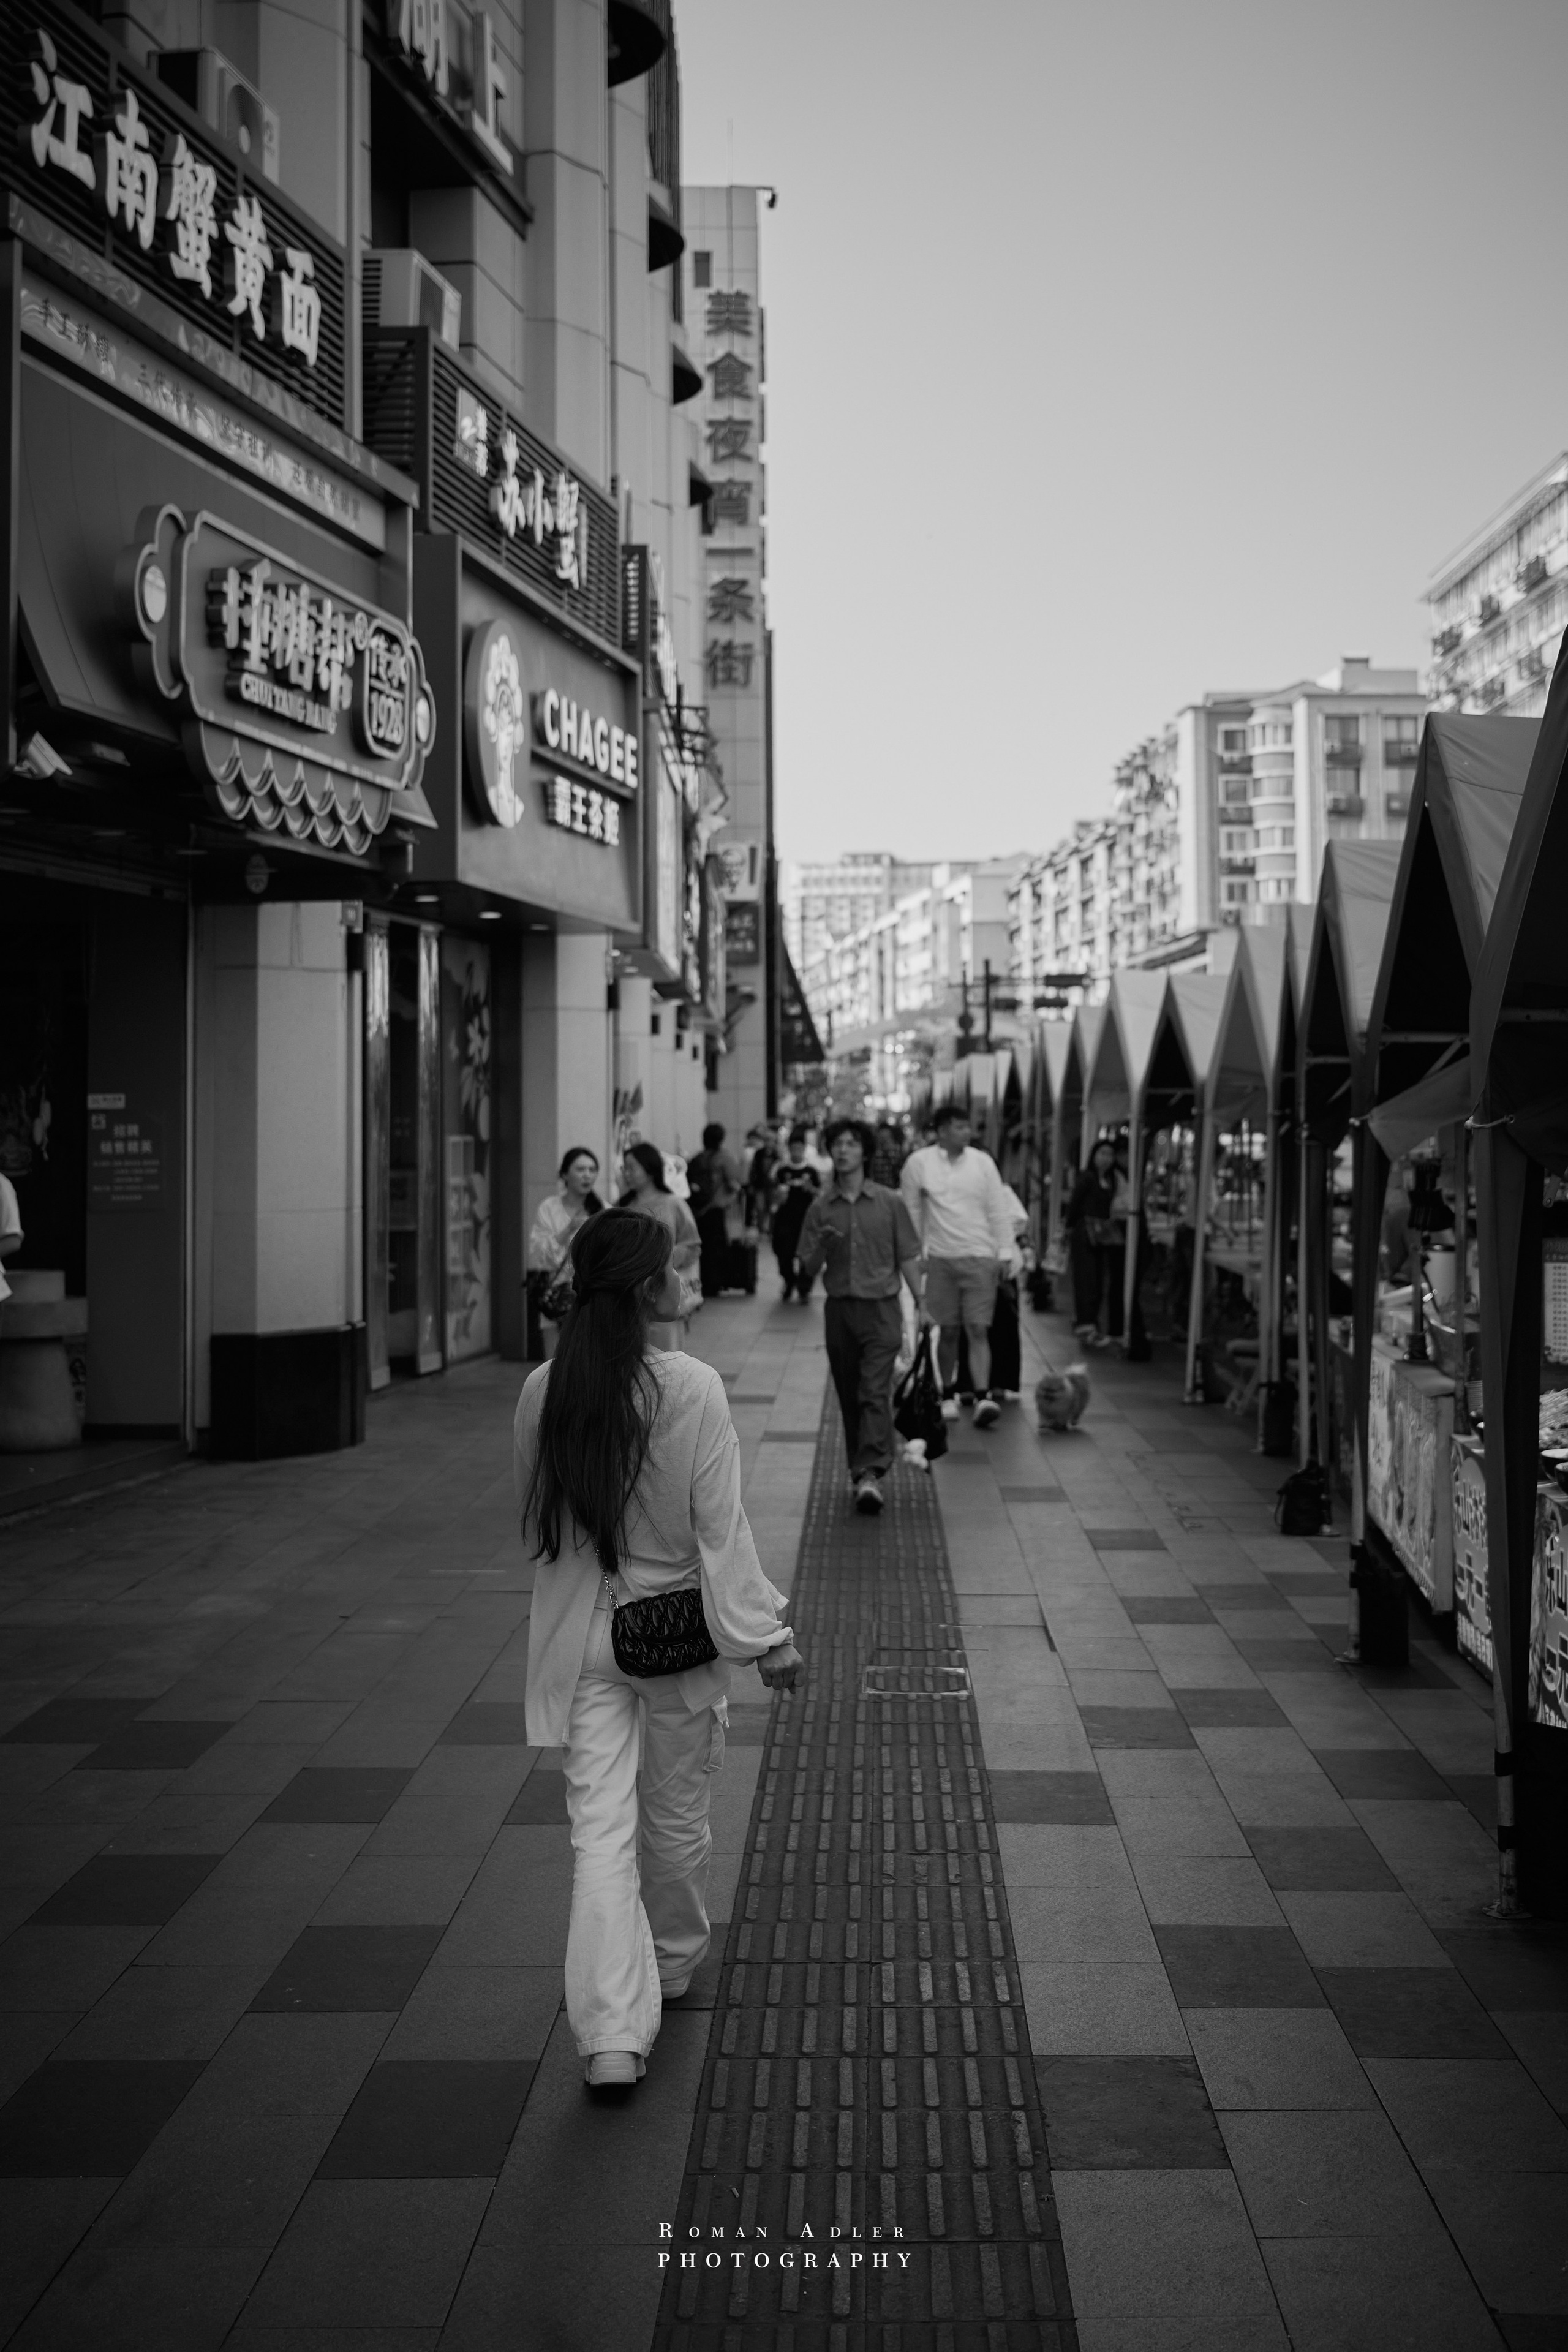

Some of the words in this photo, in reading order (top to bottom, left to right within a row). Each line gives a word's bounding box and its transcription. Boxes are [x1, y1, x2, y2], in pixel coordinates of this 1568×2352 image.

[31, 27, 321, 368] 江南蟹黄面
[371, 690, 404, 745] 1928
[543, 688, 638, 788] CHAGEE
[554, 775, 620, 846] 霸王茶姬
